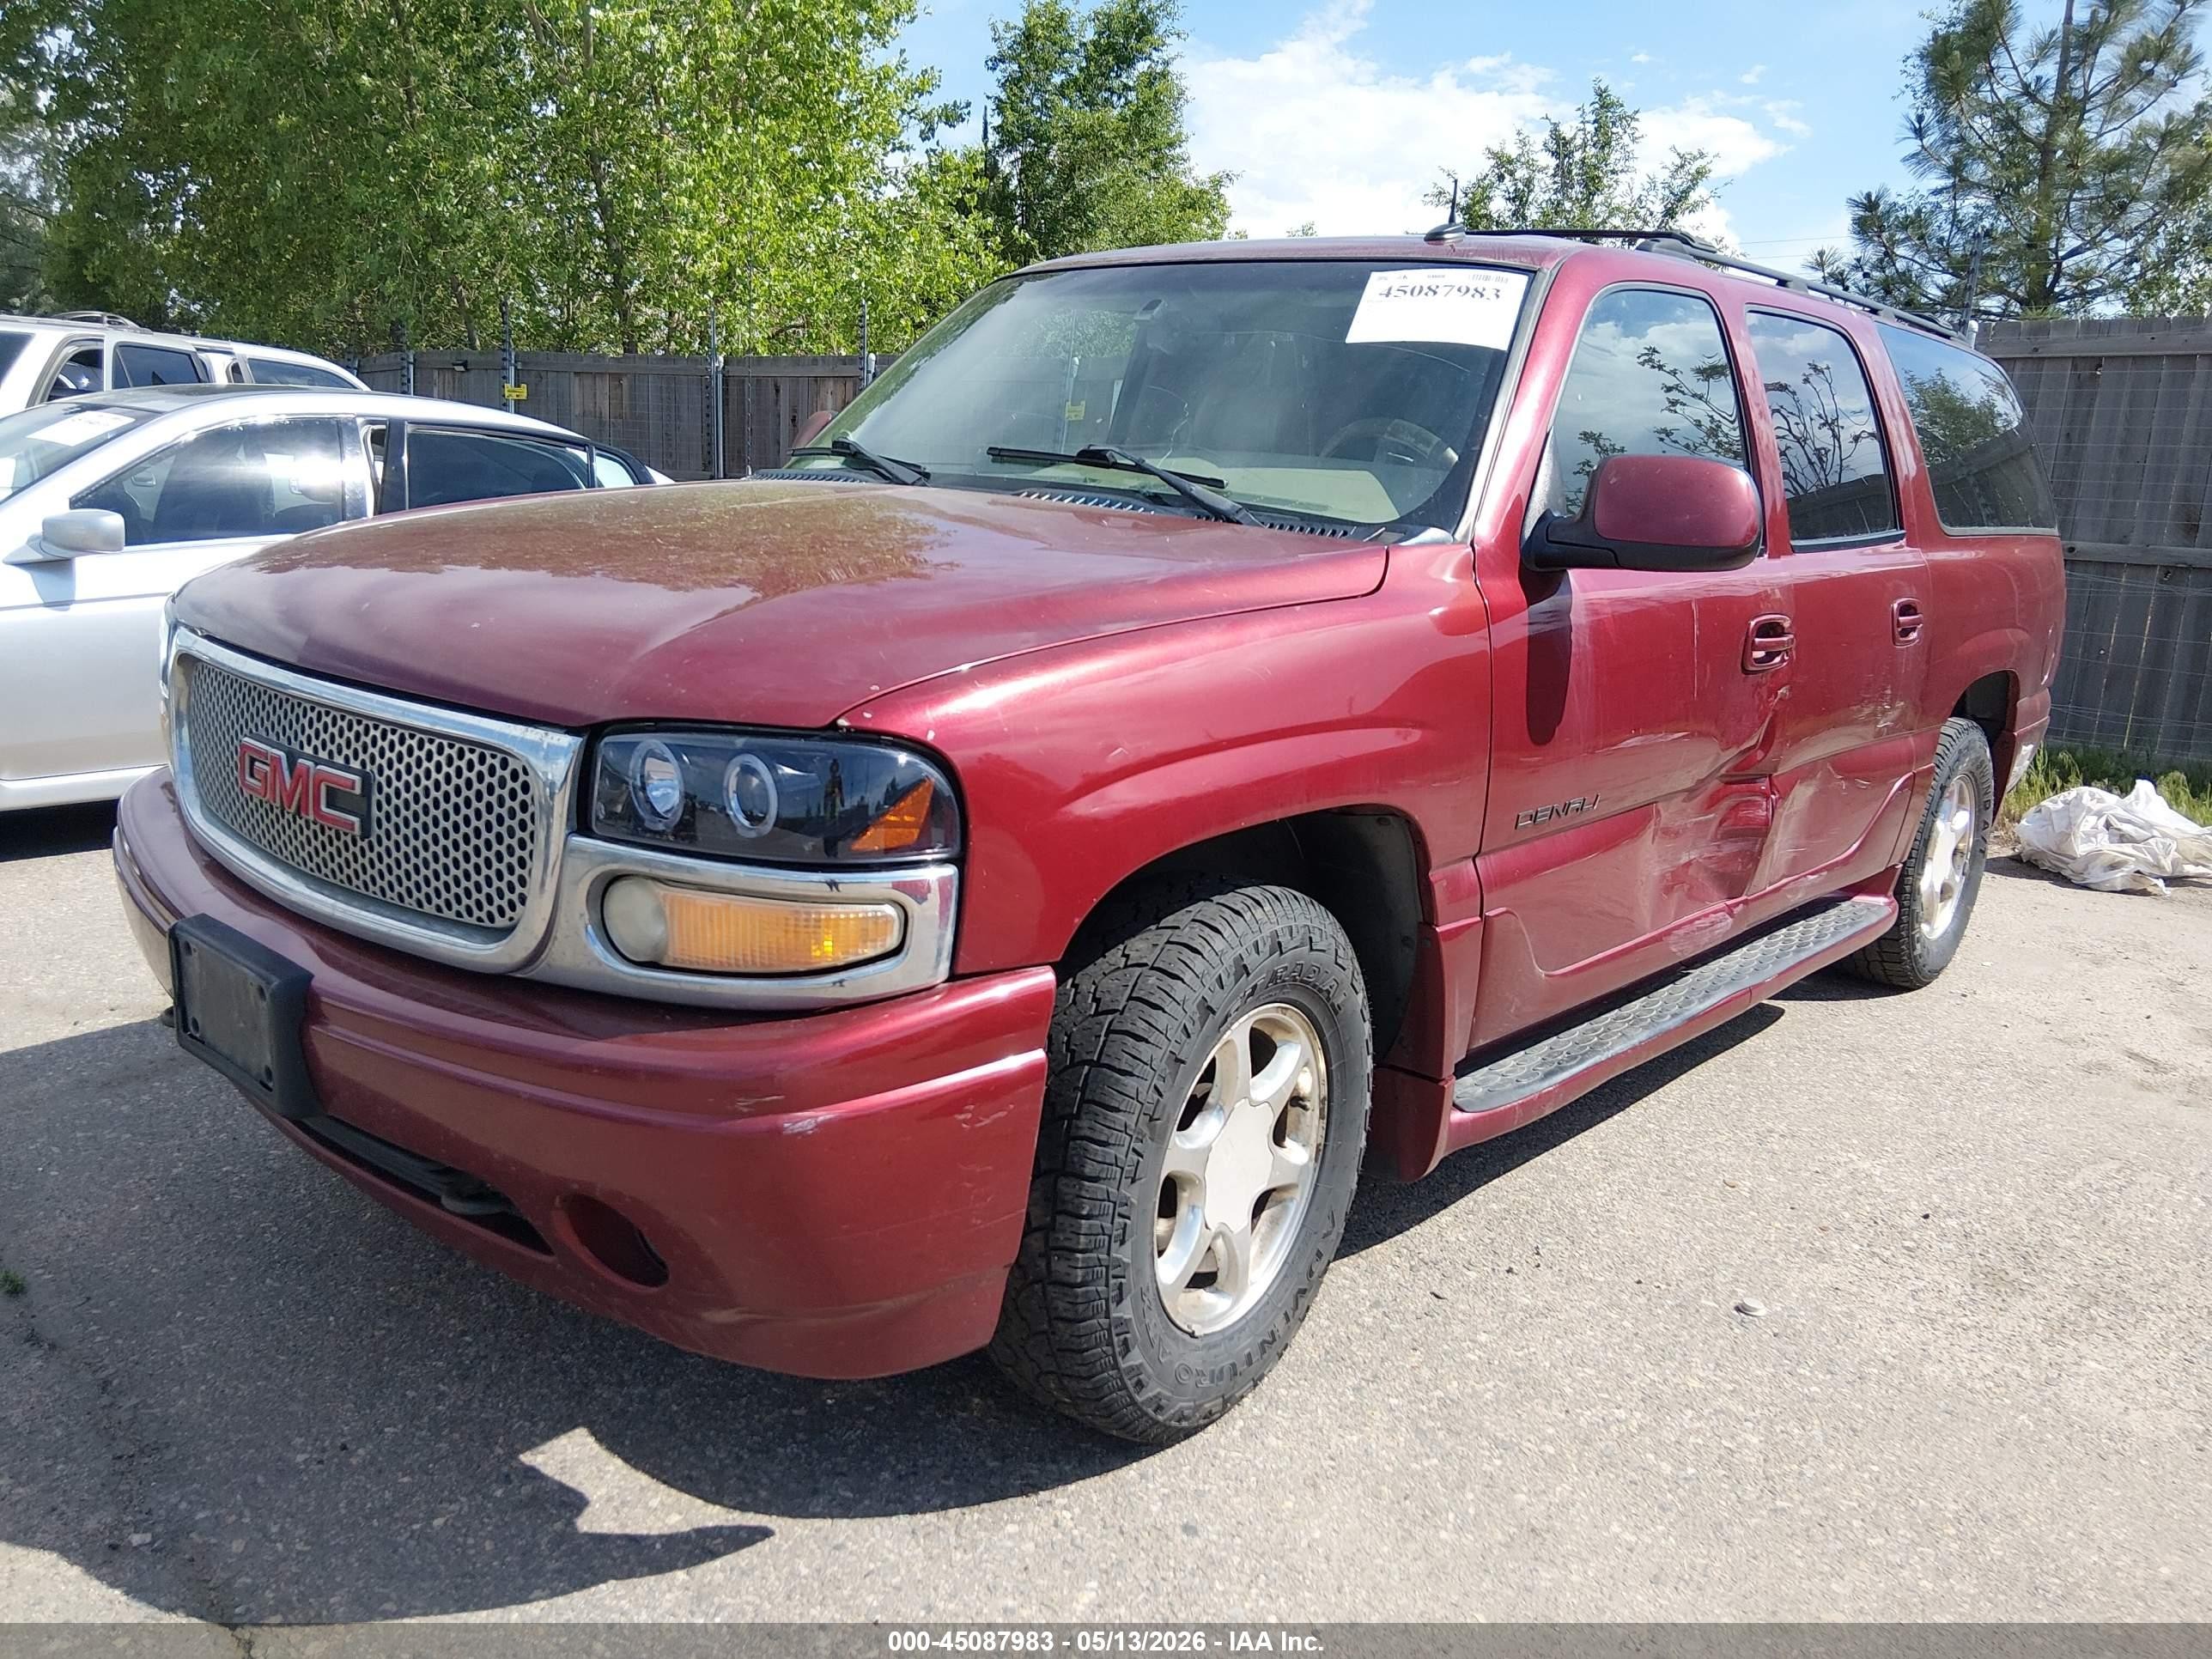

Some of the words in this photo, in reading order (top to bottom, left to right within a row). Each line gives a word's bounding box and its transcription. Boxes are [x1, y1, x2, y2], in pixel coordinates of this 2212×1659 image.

[1378, 284, 1501, 301] 45087983
[239, 736, 362, 836] GMC
[1514, 792, 1601, 830] DENALI
[1266, 960, 1347, 1015] RADIAL
[1174, 1208, 1336, 1389] ADVENTURO
